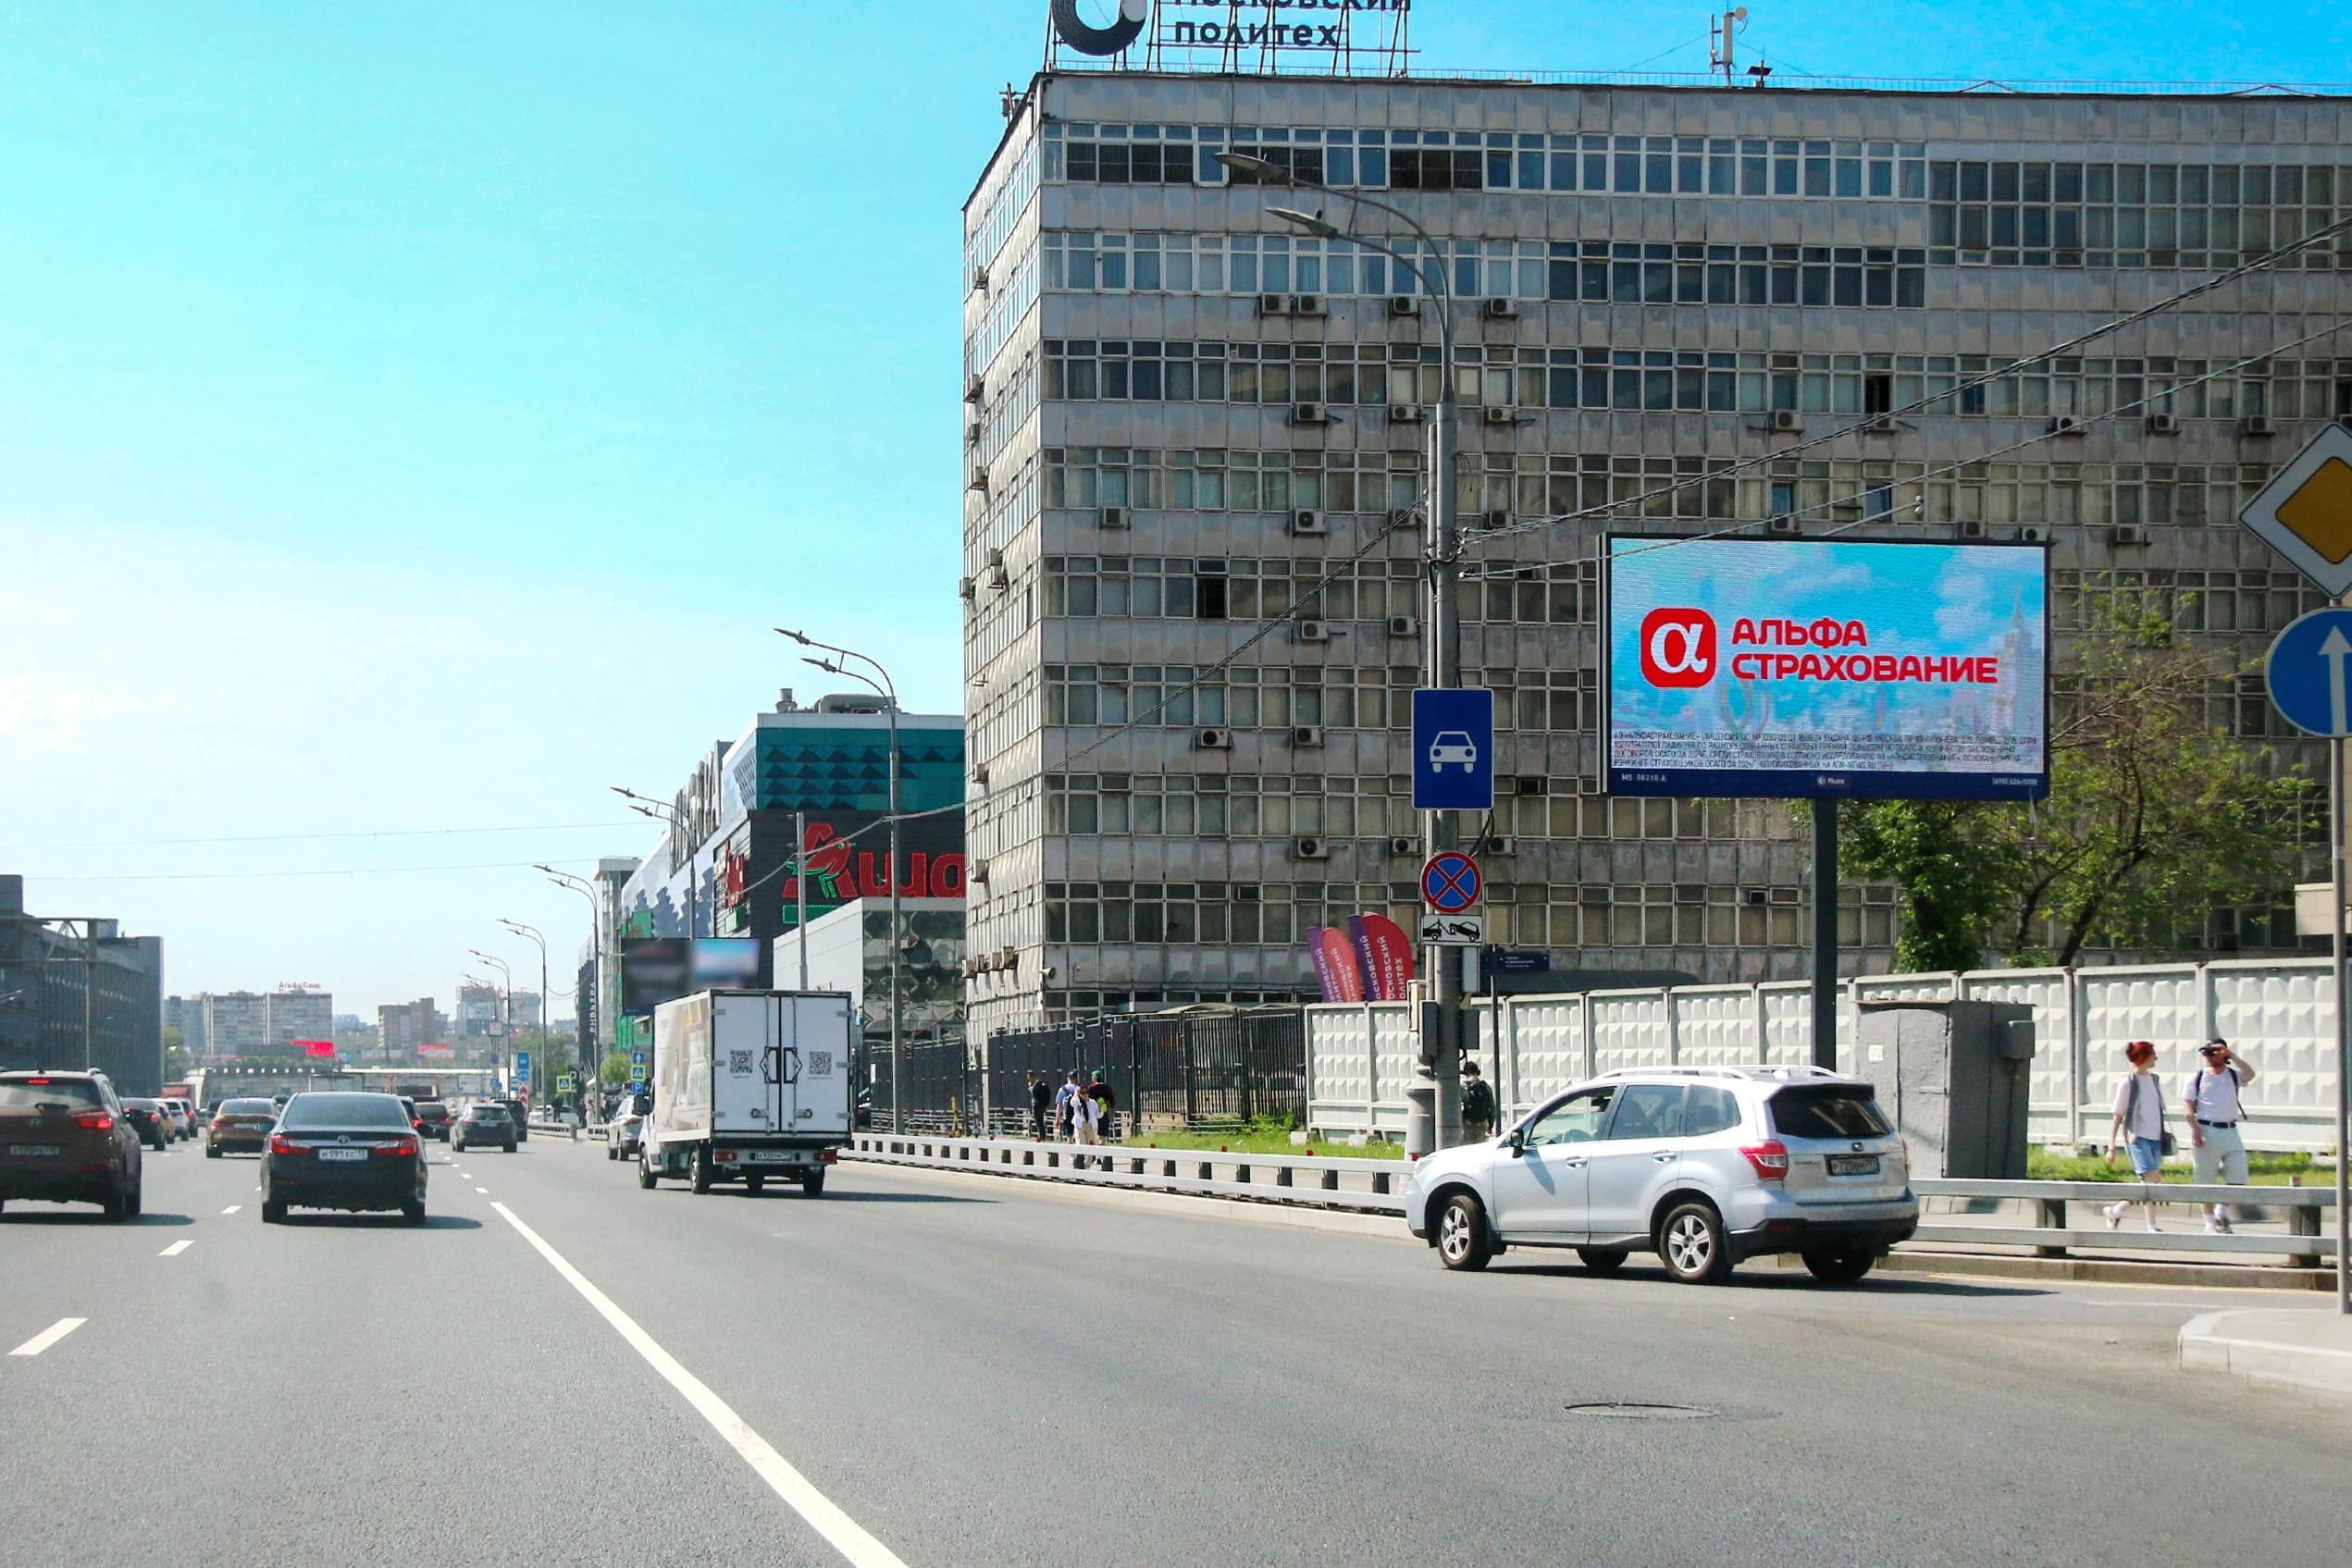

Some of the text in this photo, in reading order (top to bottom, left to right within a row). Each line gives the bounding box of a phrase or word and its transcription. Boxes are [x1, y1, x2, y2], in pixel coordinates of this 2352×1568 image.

[1175, 22, 1338, 46] политех
[1732, 617, 1867, 647] АЛЬФА
[1732, 654, 1999, 684] СТРАХОВАНИЕ
[1359, 935, 1381, 1000] осковский
[1377, 935, 1395, 1000] осковский
[1394, 957, 1406, 999] олитех
